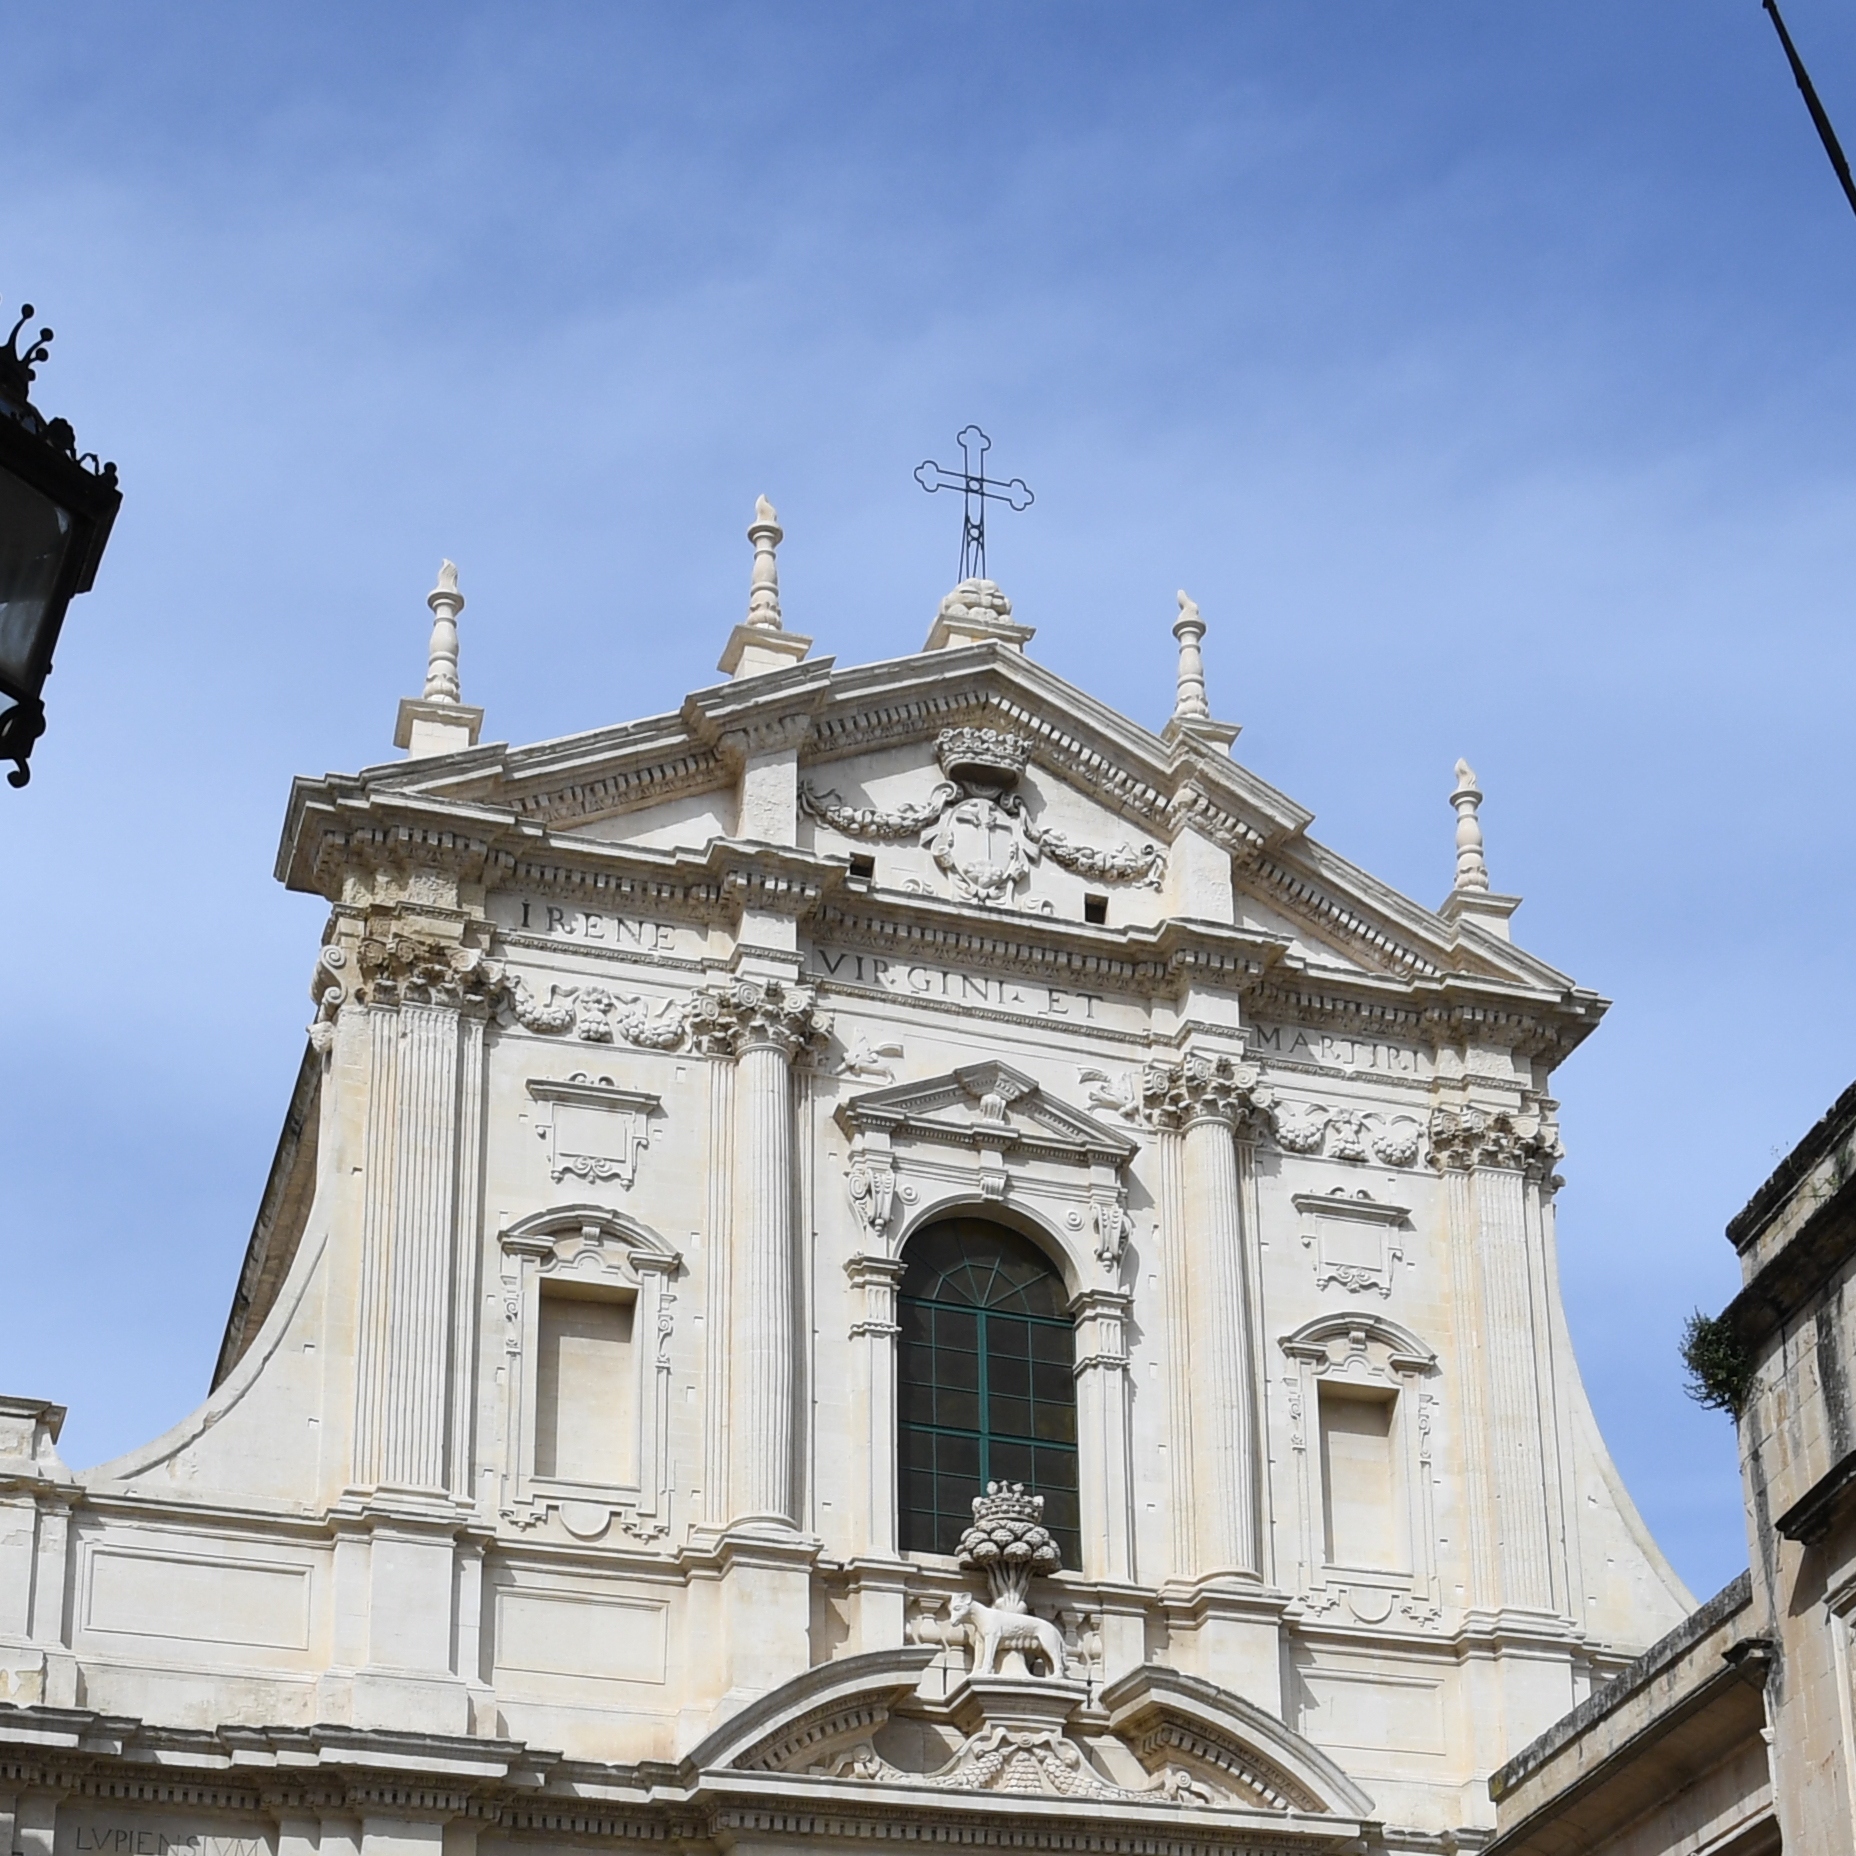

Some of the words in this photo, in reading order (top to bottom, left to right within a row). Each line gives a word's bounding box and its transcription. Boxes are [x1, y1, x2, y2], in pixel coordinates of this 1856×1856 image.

[520, 900, 676, 951] IRENE
[1046, 987, 1104, 1019] ET
[1255, 1024, 1419, 1073] MARTIRI
